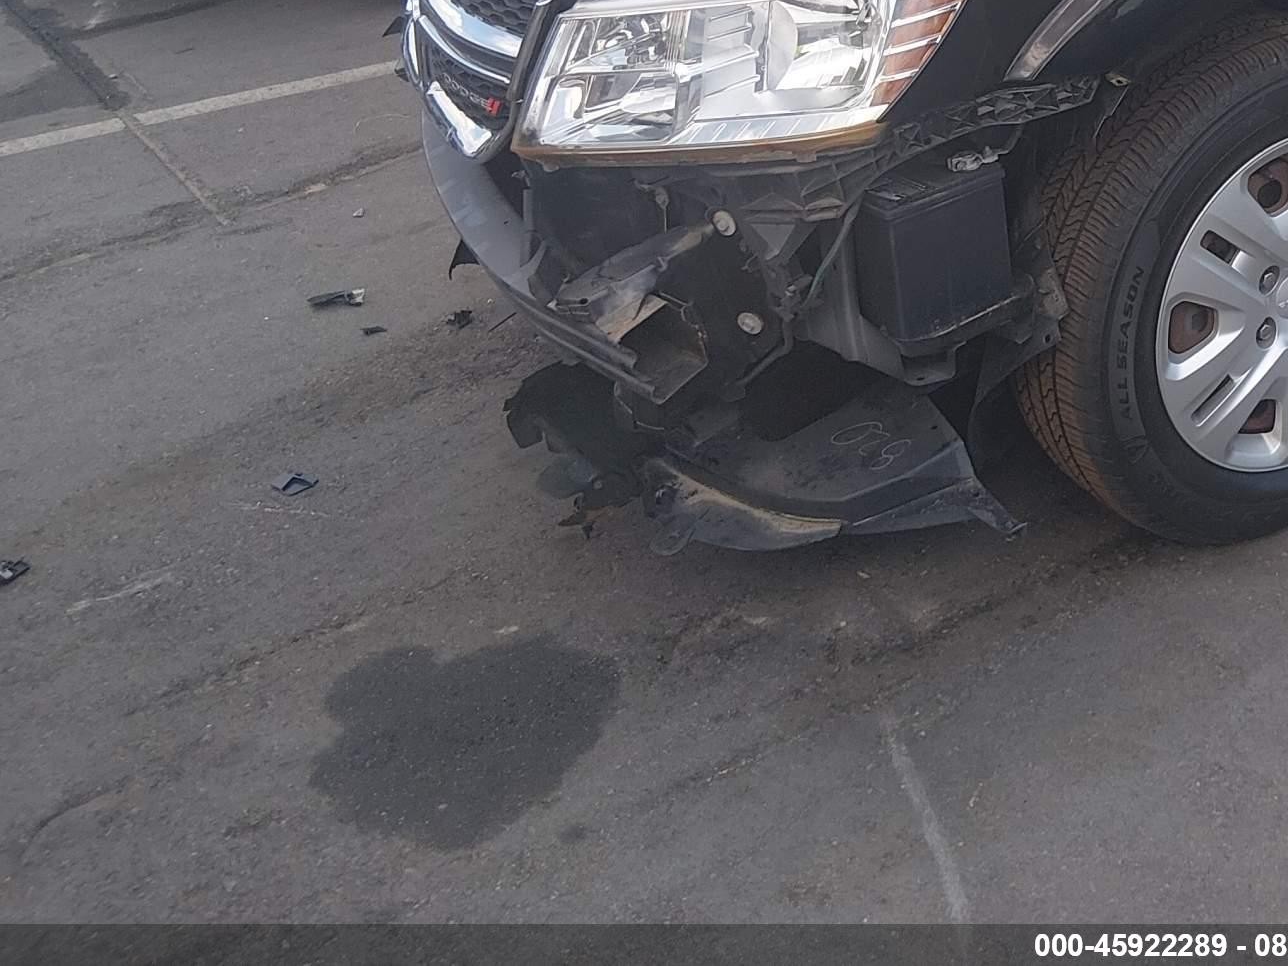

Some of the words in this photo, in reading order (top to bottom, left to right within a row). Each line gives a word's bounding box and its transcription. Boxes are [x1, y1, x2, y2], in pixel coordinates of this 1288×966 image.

[442, 72, 488, 110] DODGE
[1116, 265, 1145, 370] SEASON
[1117, 375, 1133, 420] ALL
